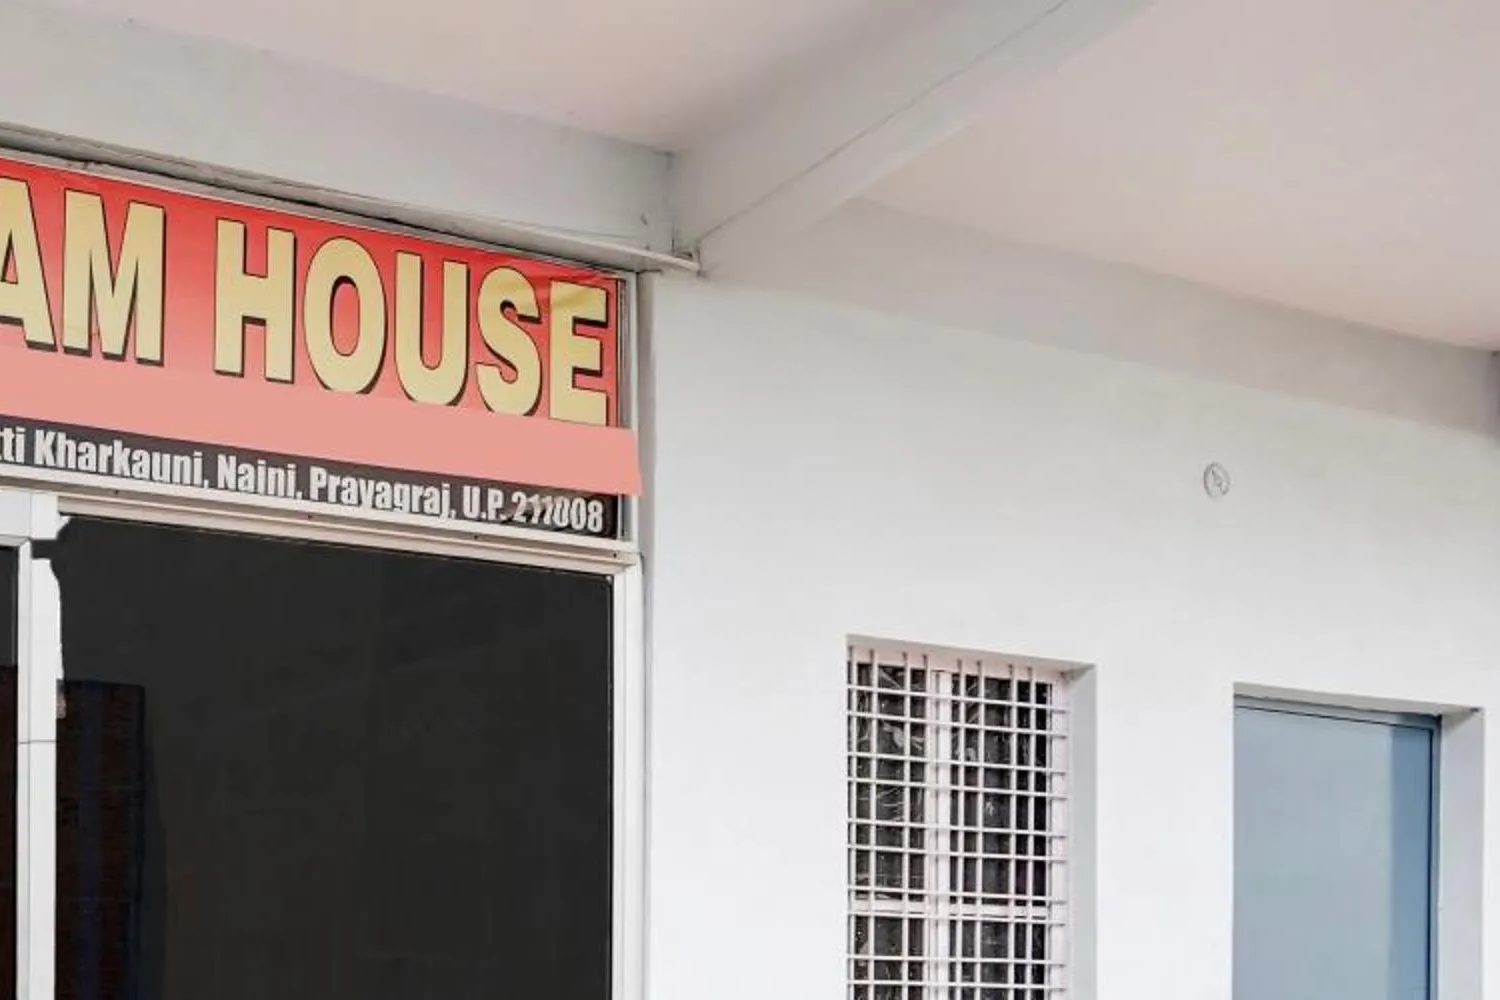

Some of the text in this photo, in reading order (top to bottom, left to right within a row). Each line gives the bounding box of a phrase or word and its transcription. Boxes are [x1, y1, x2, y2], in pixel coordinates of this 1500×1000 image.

[213, 217, 609, 428] HOUSE
[34, 428, 210, 490] Kharkauni,
[217, 453, 304, 499] Naini,
[309, 465, 457, 522] Prayagraj,
